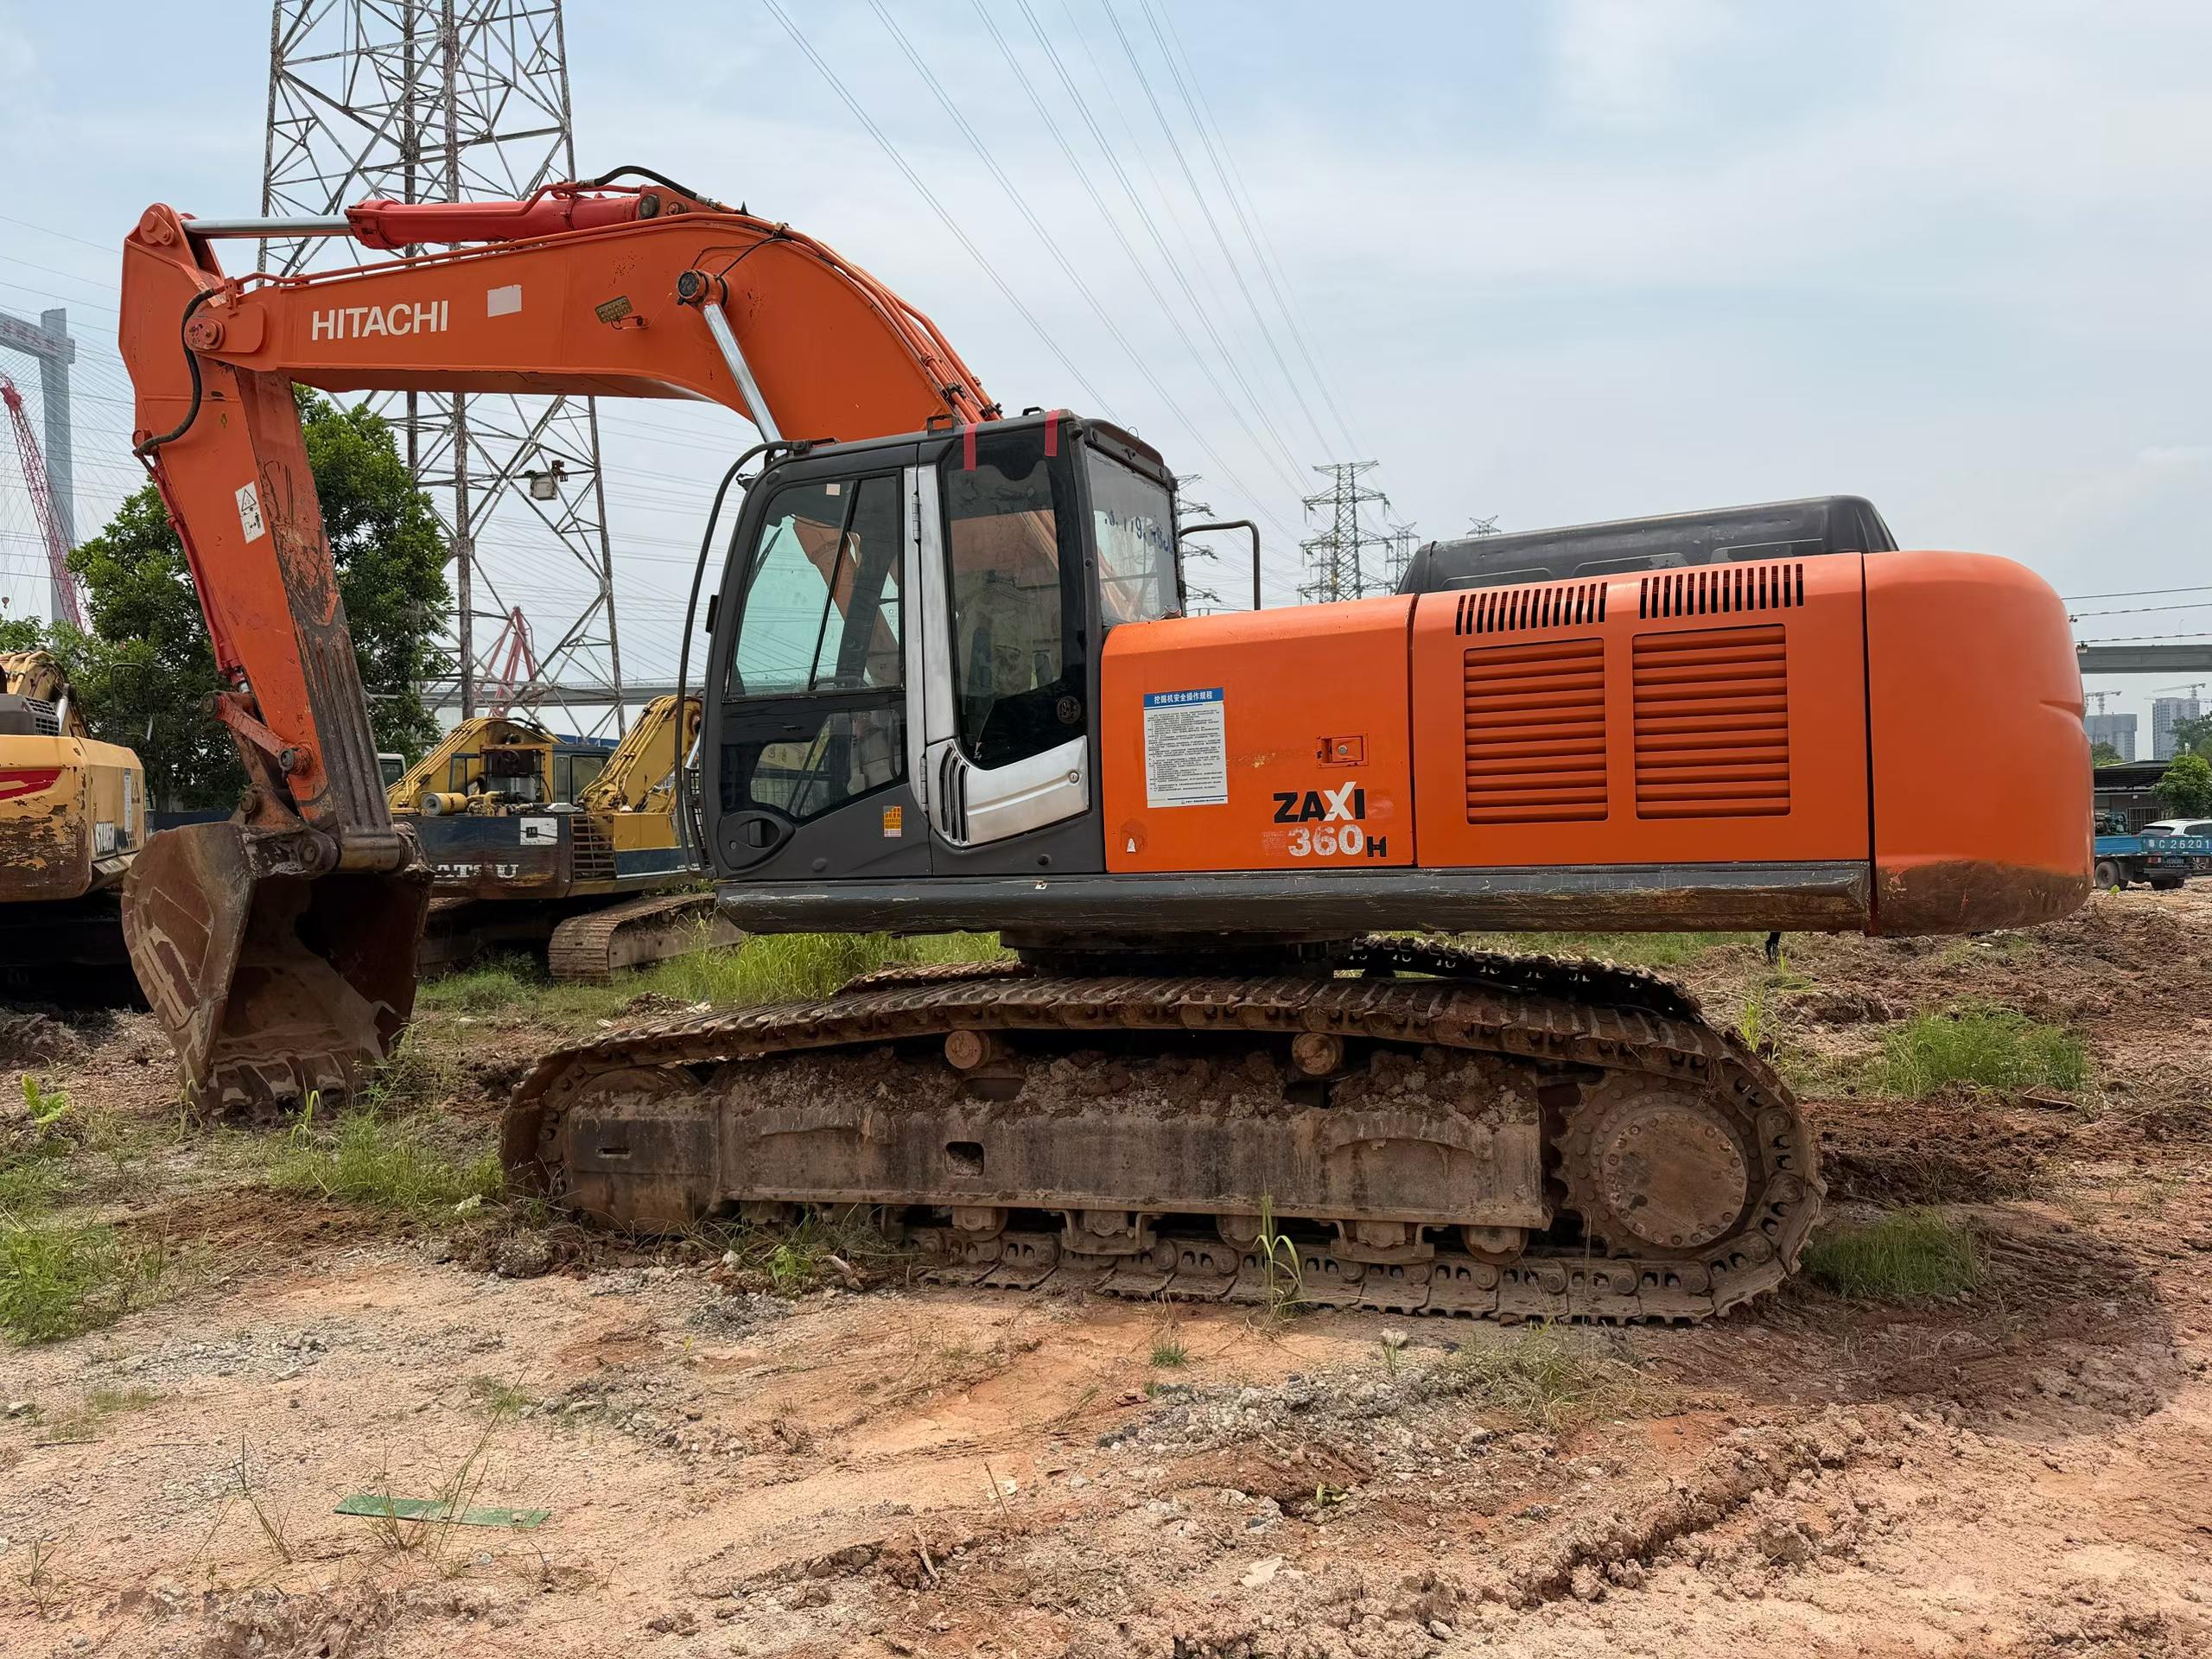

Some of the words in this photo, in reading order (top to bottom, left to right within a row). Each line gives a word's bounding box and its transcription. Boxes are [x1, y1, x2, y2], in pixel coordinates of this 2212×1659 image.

[312, 300, 448, 340] HITACHI
[1154, 690, 1213, 704] 挖掘机安全操作规程
[1273, 781, 1366, 823] ZAXI
